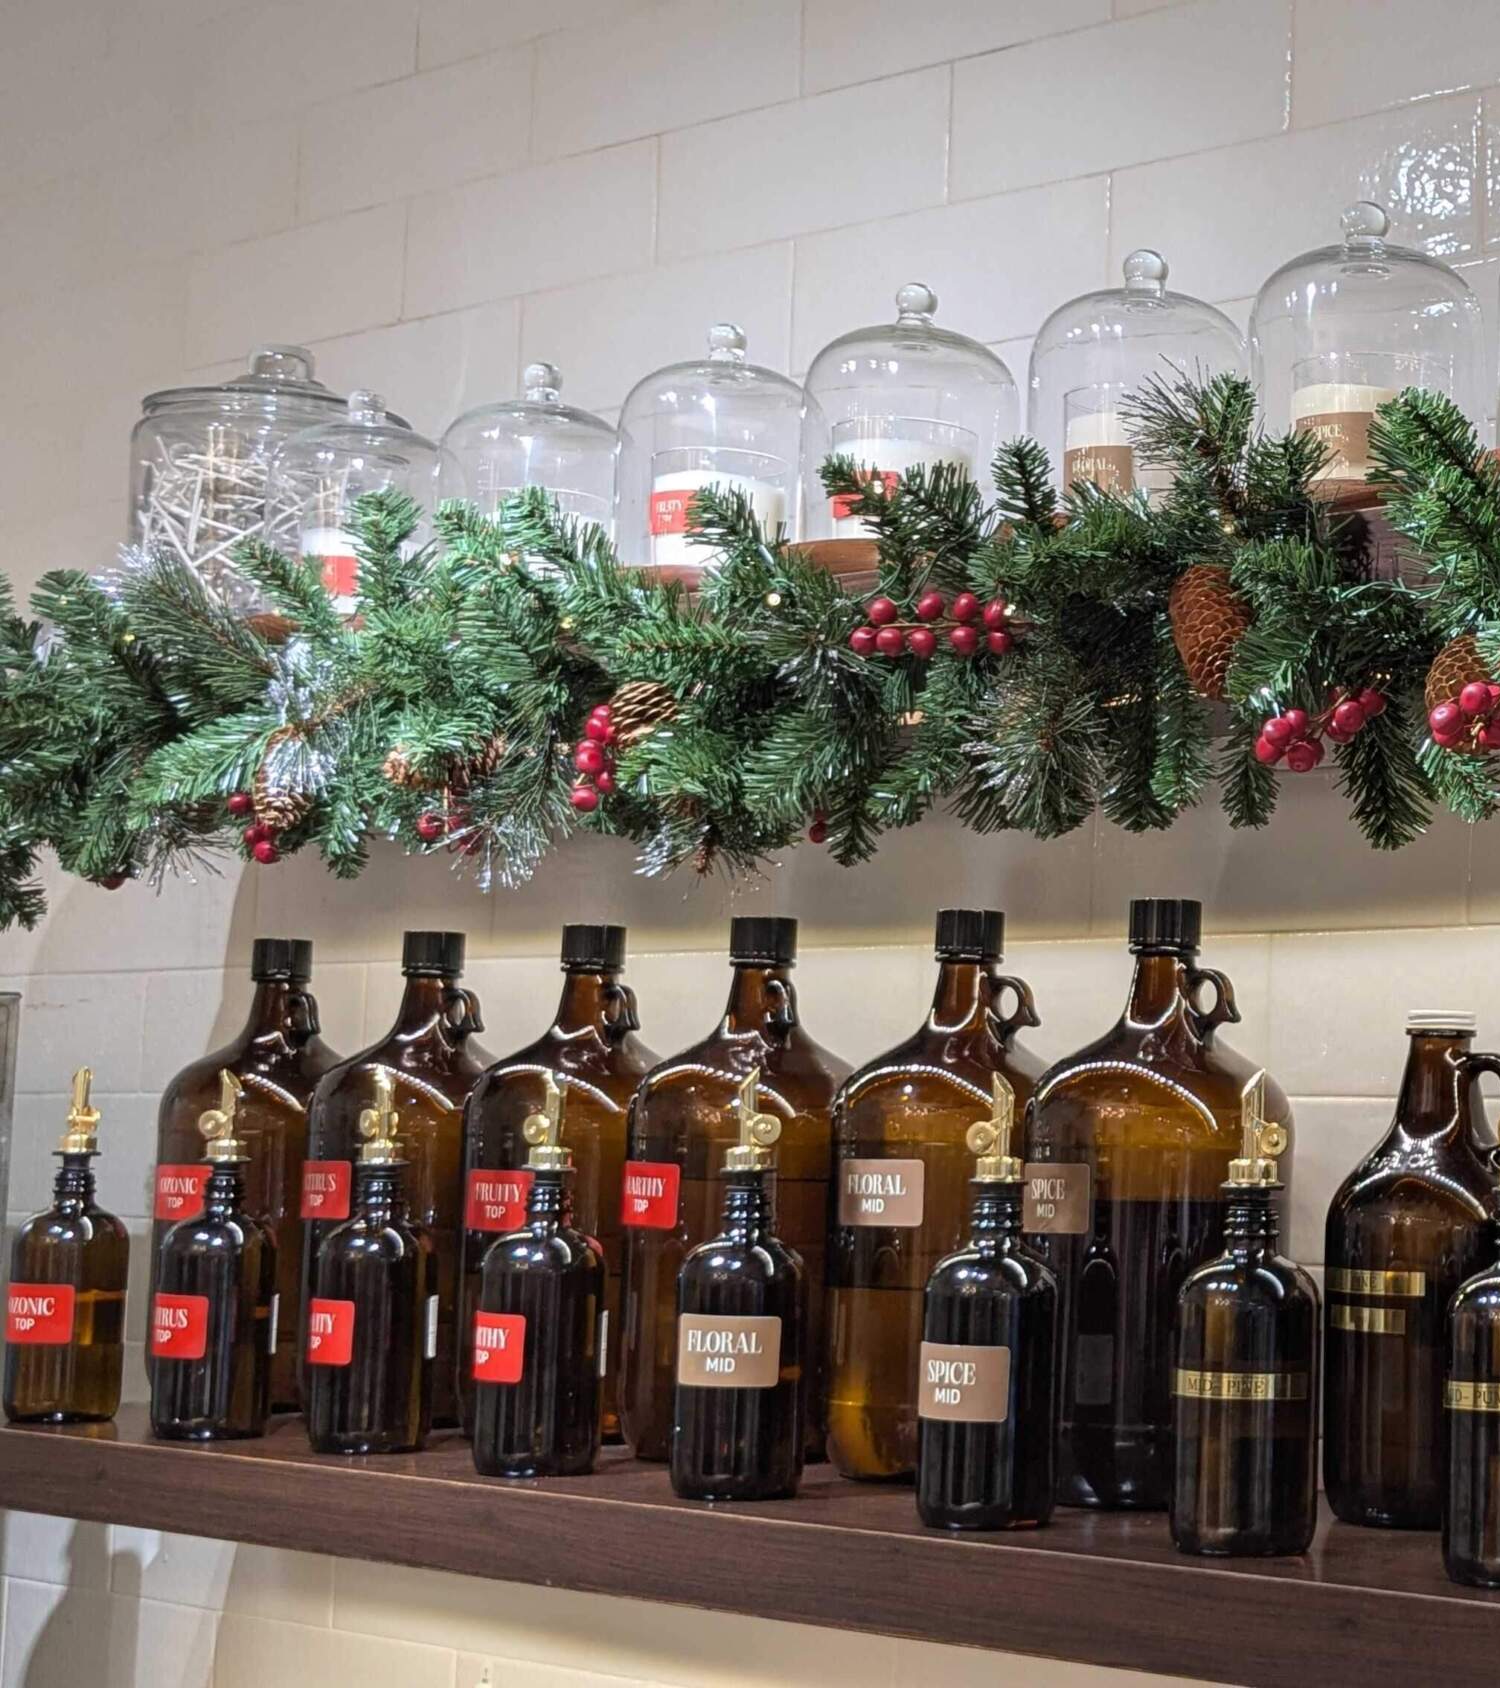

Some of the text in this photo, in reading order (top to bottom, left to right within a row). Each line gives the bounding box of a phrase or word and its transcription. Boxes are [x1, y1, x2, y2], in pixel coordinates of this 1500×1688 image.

[160, 1177, 198, 1194] OZONIC
[475, 1182, 523, 1203] FRUITY
[848, 1173, 906, 1196] FLORAL
[1031, 1178, 1066, 1200] SPICE
[167, 1197, 184, 1209] TOP
[309, 1194, 324, 1207] TOP
[633, 1199, 649, 1212] TOP
[861, 1199, 885, 1214] MID
[485, 1205, 506, 1218] TOP
[1036, 1203, 1056, 1218] MID
[15, 1317, 35, 1331] TOP
[687, 1329, 763, 1355] FLORAL
[705, 1356, 735, 1374] MID
[927, 1359, 976, 1386] SPICE
[934, 1387, 961, 1405] MID
